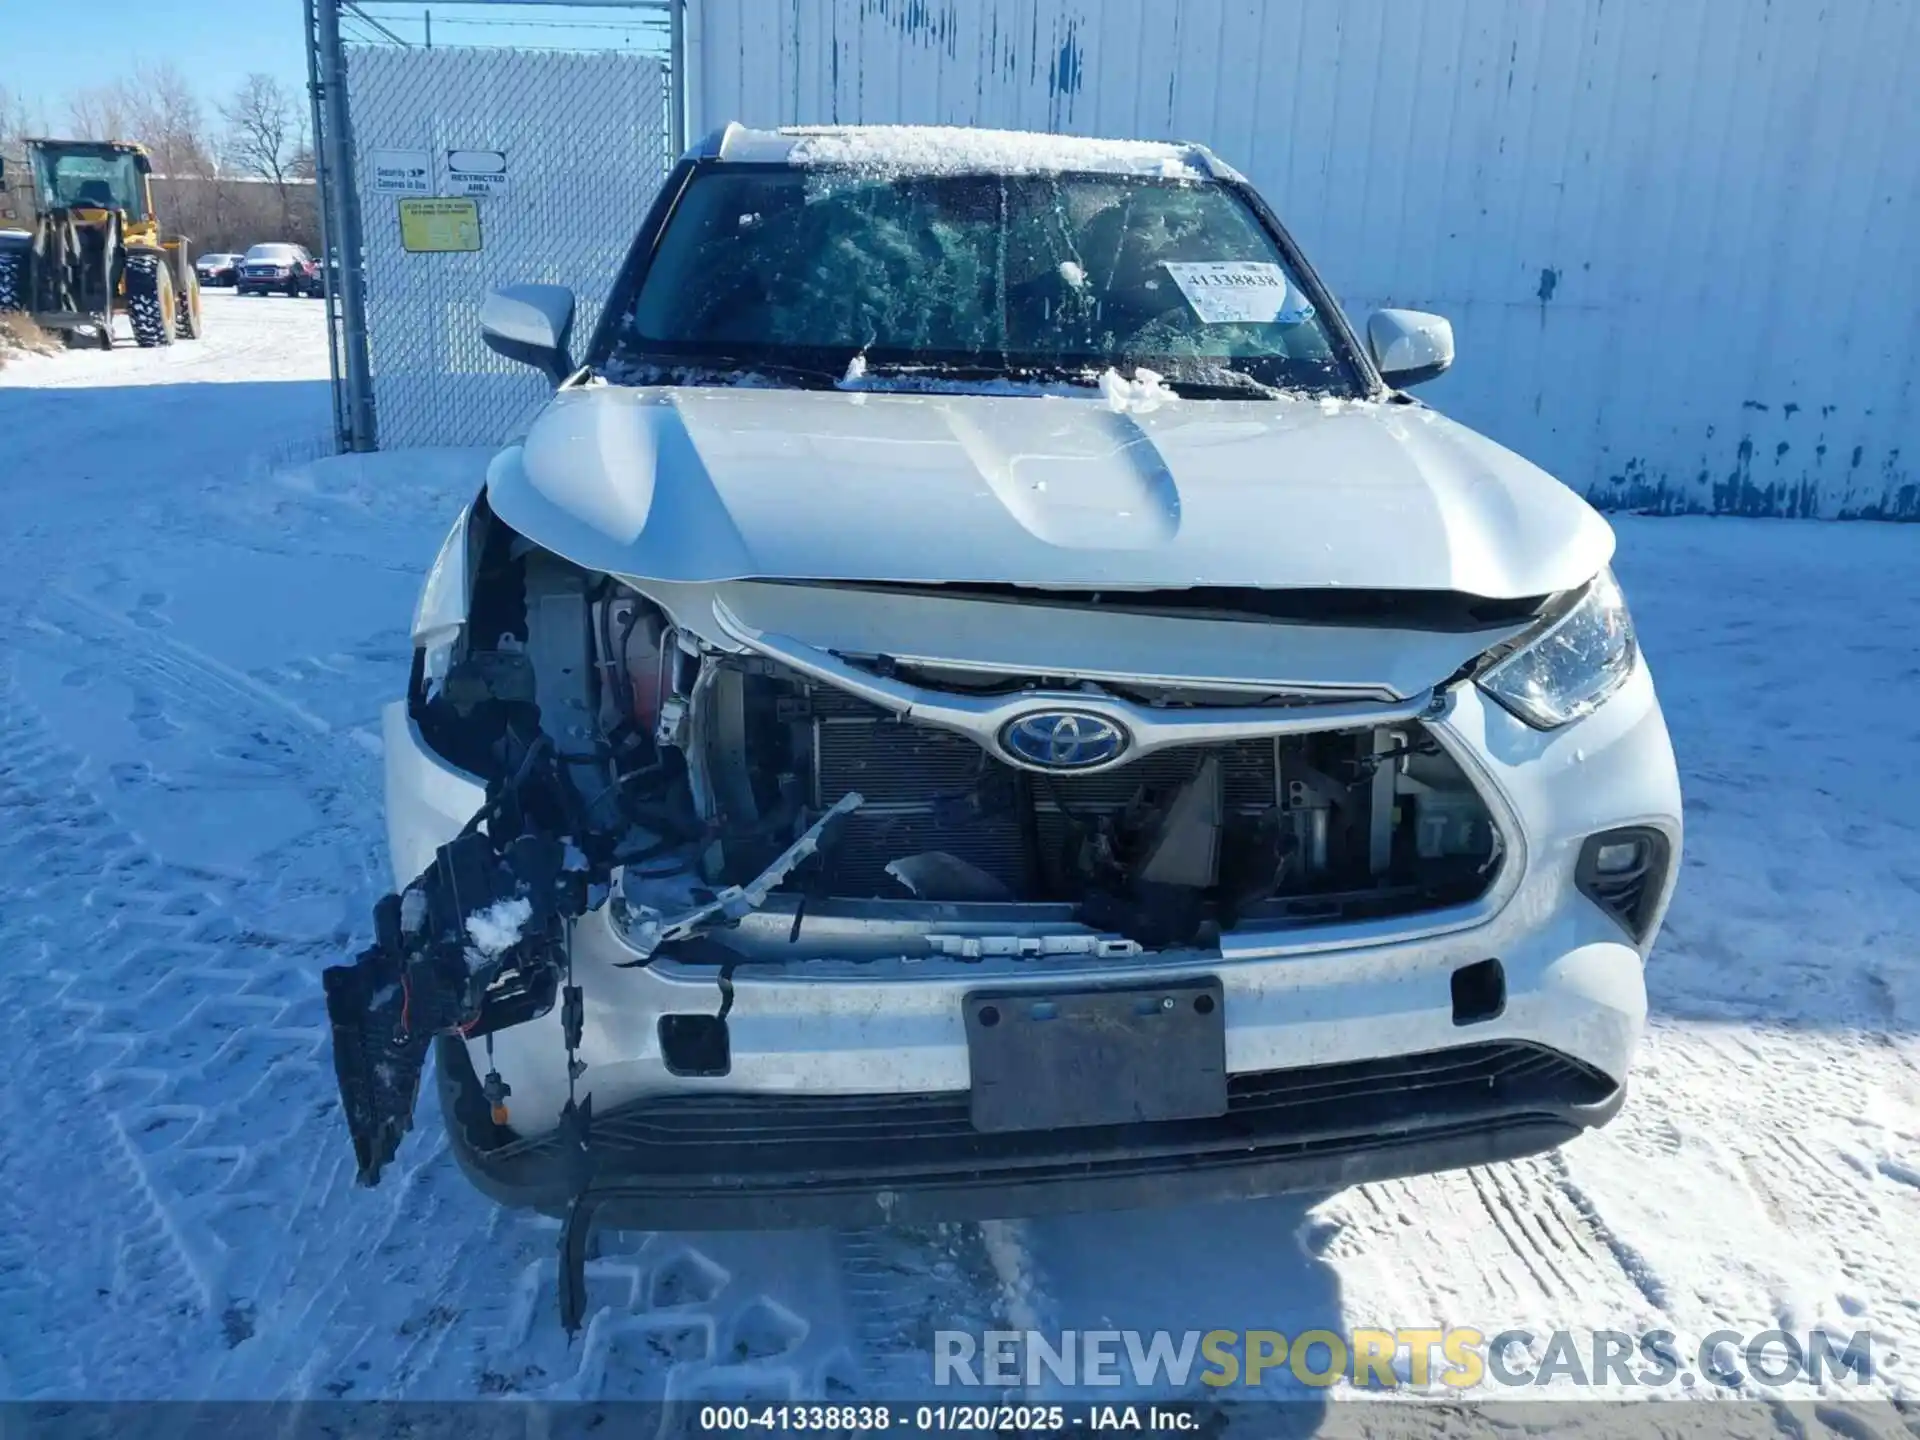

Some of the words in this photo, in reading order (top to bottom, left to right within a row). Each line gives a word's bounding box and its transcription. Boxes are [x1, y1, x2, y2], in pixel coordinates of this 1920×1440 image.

[451, 174, 505, 182] RESTRICTED
[467, 183, 491, 191] AREA
[1188, 274, 1280, 287] 41338838
